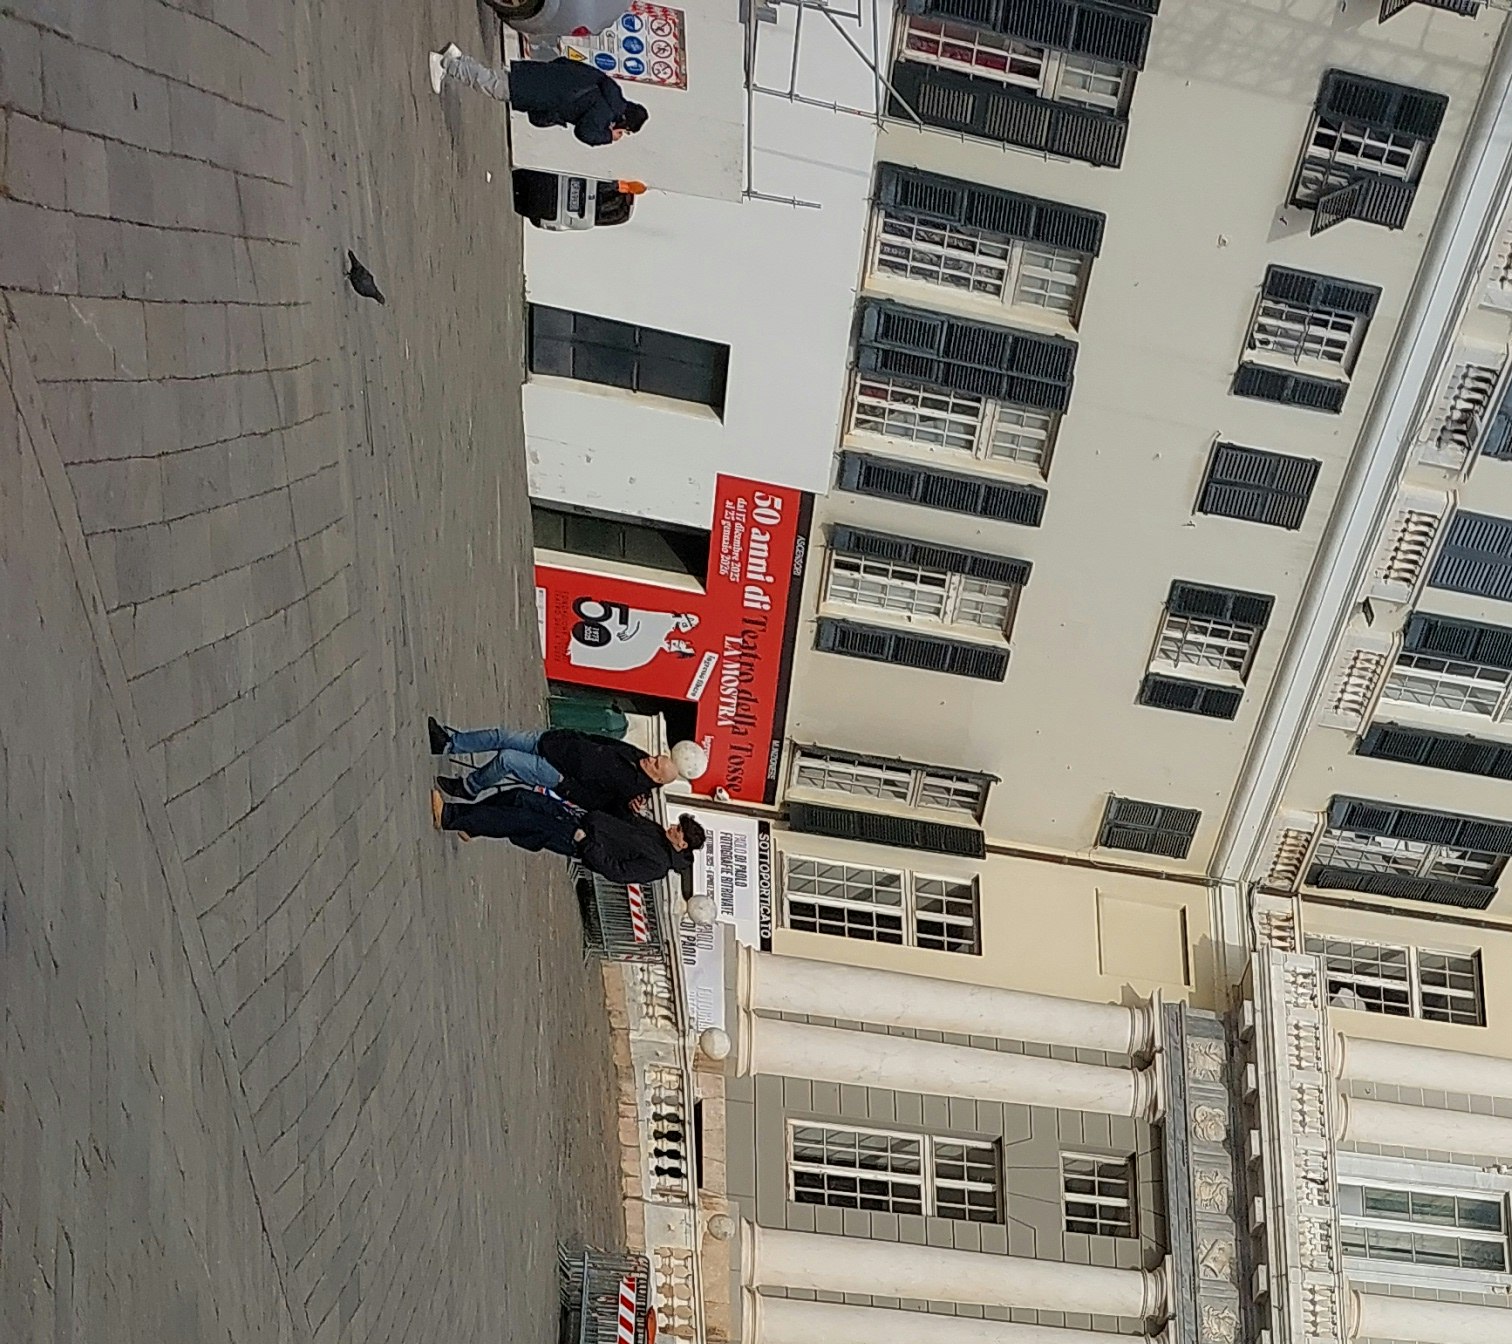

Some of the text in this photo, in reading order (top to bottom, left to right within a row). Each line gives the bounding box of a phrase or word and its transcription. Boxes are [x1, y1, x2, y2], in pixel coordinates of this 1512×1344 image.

[718, 499, 736, 576] al 25 gennaio 2026
[729, 497, 748, 583] dal 17 dicembre 2025
[792, 535, 807, 577] ASCENSORI
[690, 655, 716, 697] Ingresso libero
[725, 491, 783, 793] 50 anni di Teatro della Tosse
[716, 635, 744, 727] LA MOSTRA
[719, 831, 734, 916] FOTOGRAFIE RITROVATE
[734, 833, 748, 887] PAOLO DI PAOLO
[758, 832, 771, 939] SOTTOPORTICATO
[680, 921, 697, 966] DI PAOLO
[696, 924, 714, 951] PAOLO
